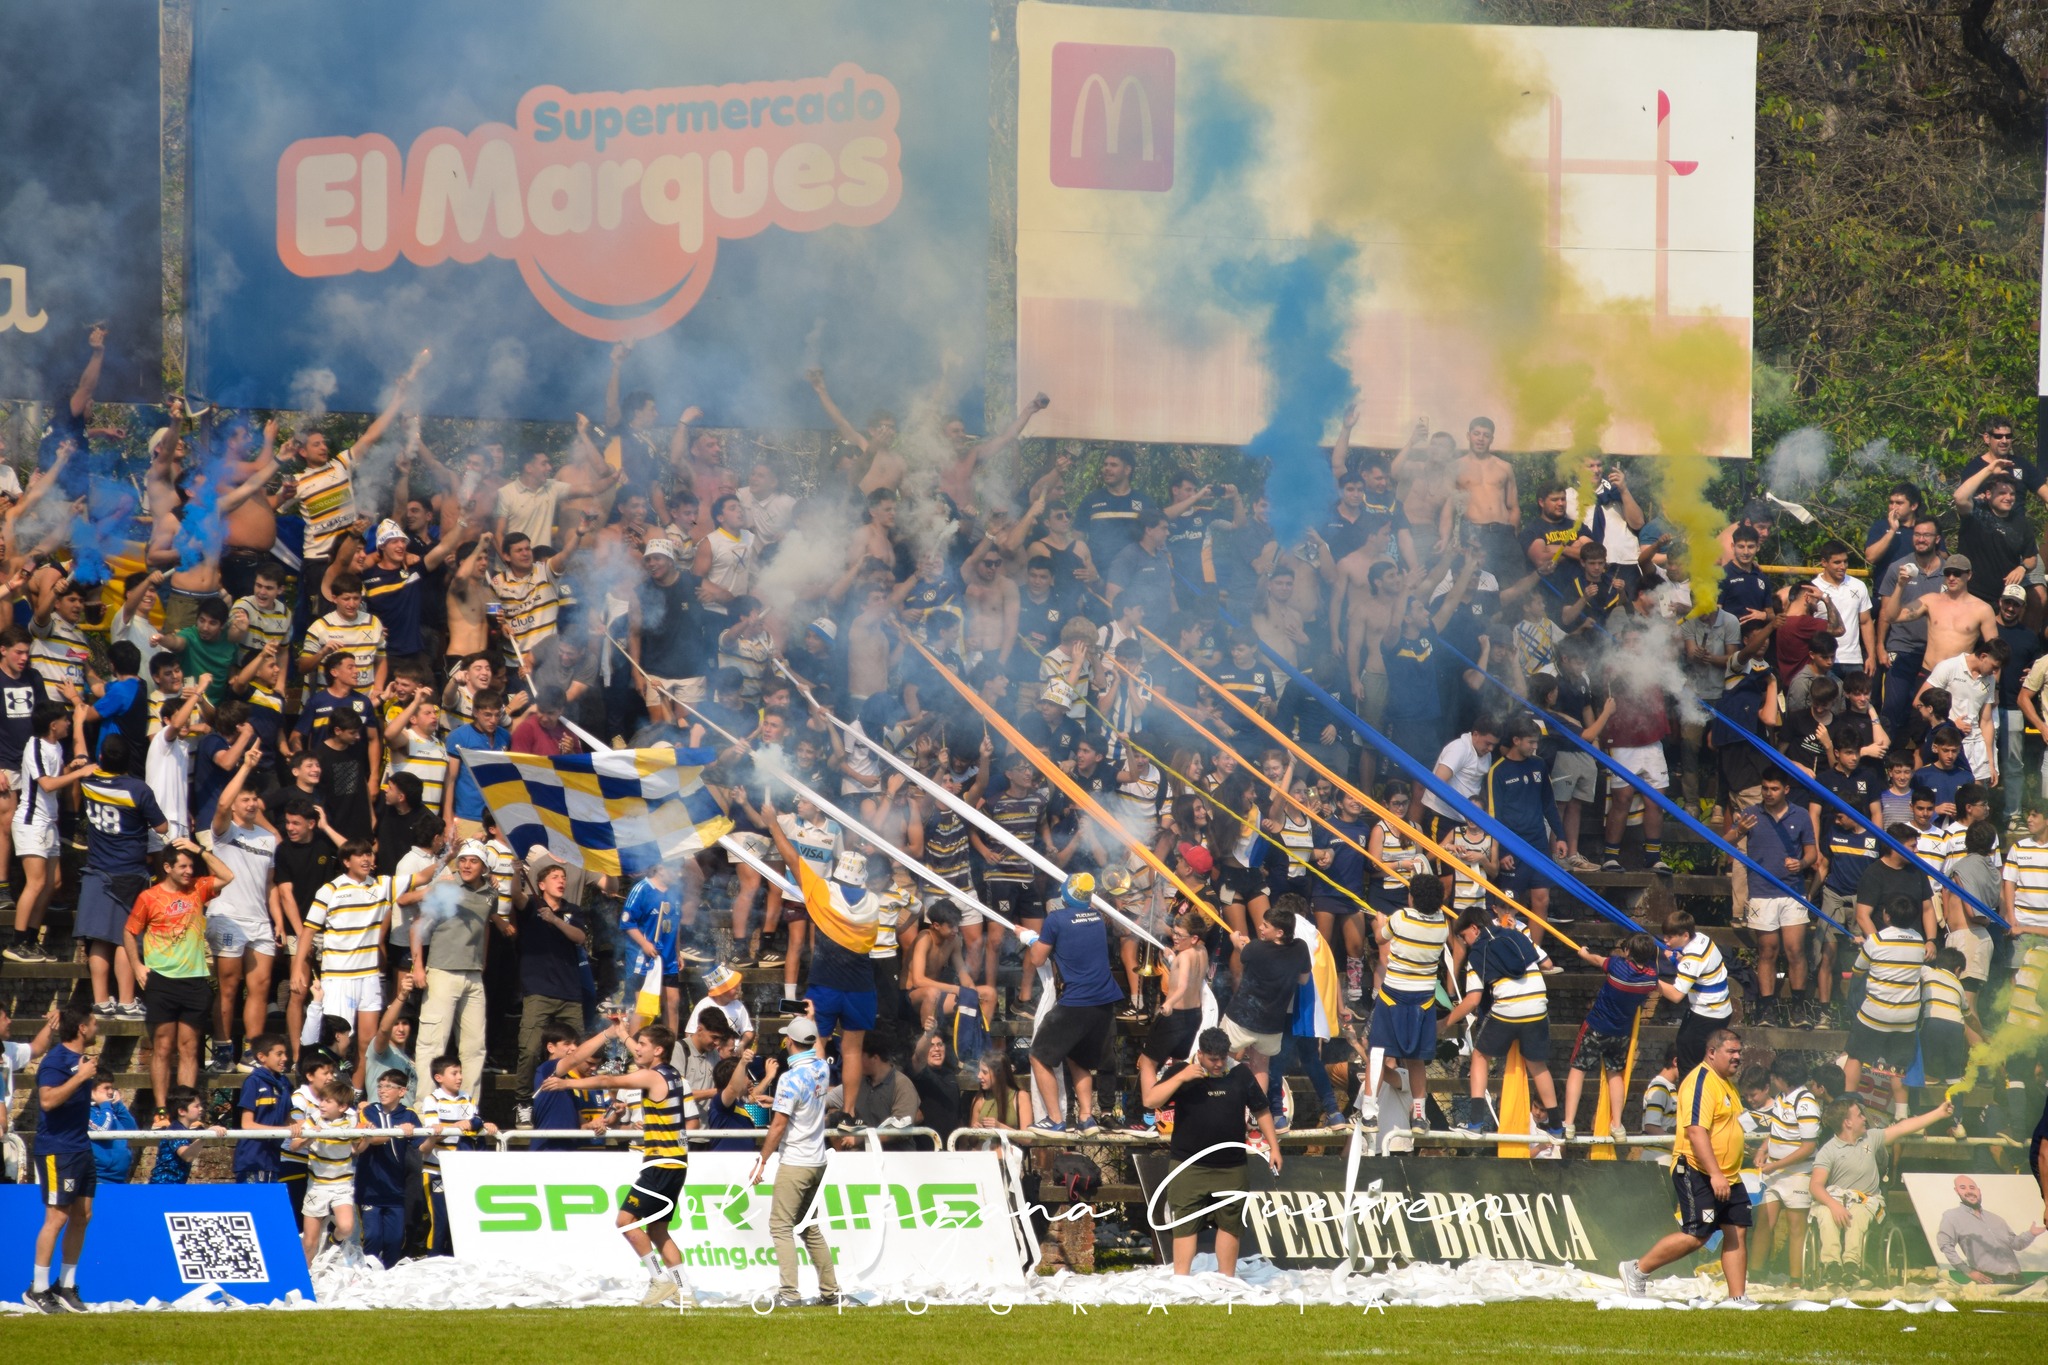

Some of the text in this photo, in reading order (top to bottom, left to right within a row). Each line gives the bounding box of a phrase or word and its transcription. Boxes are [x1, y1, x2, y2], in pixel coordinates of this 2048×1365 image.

[533, 76, 886, 153] Supermercado
[295, 135, 891, 257] El Marques
[86, 800, 121, 835] 48
[800, 846, 825, 860] VISA
[1249, 1190, 1599, 1261] FERNET BRANCA
